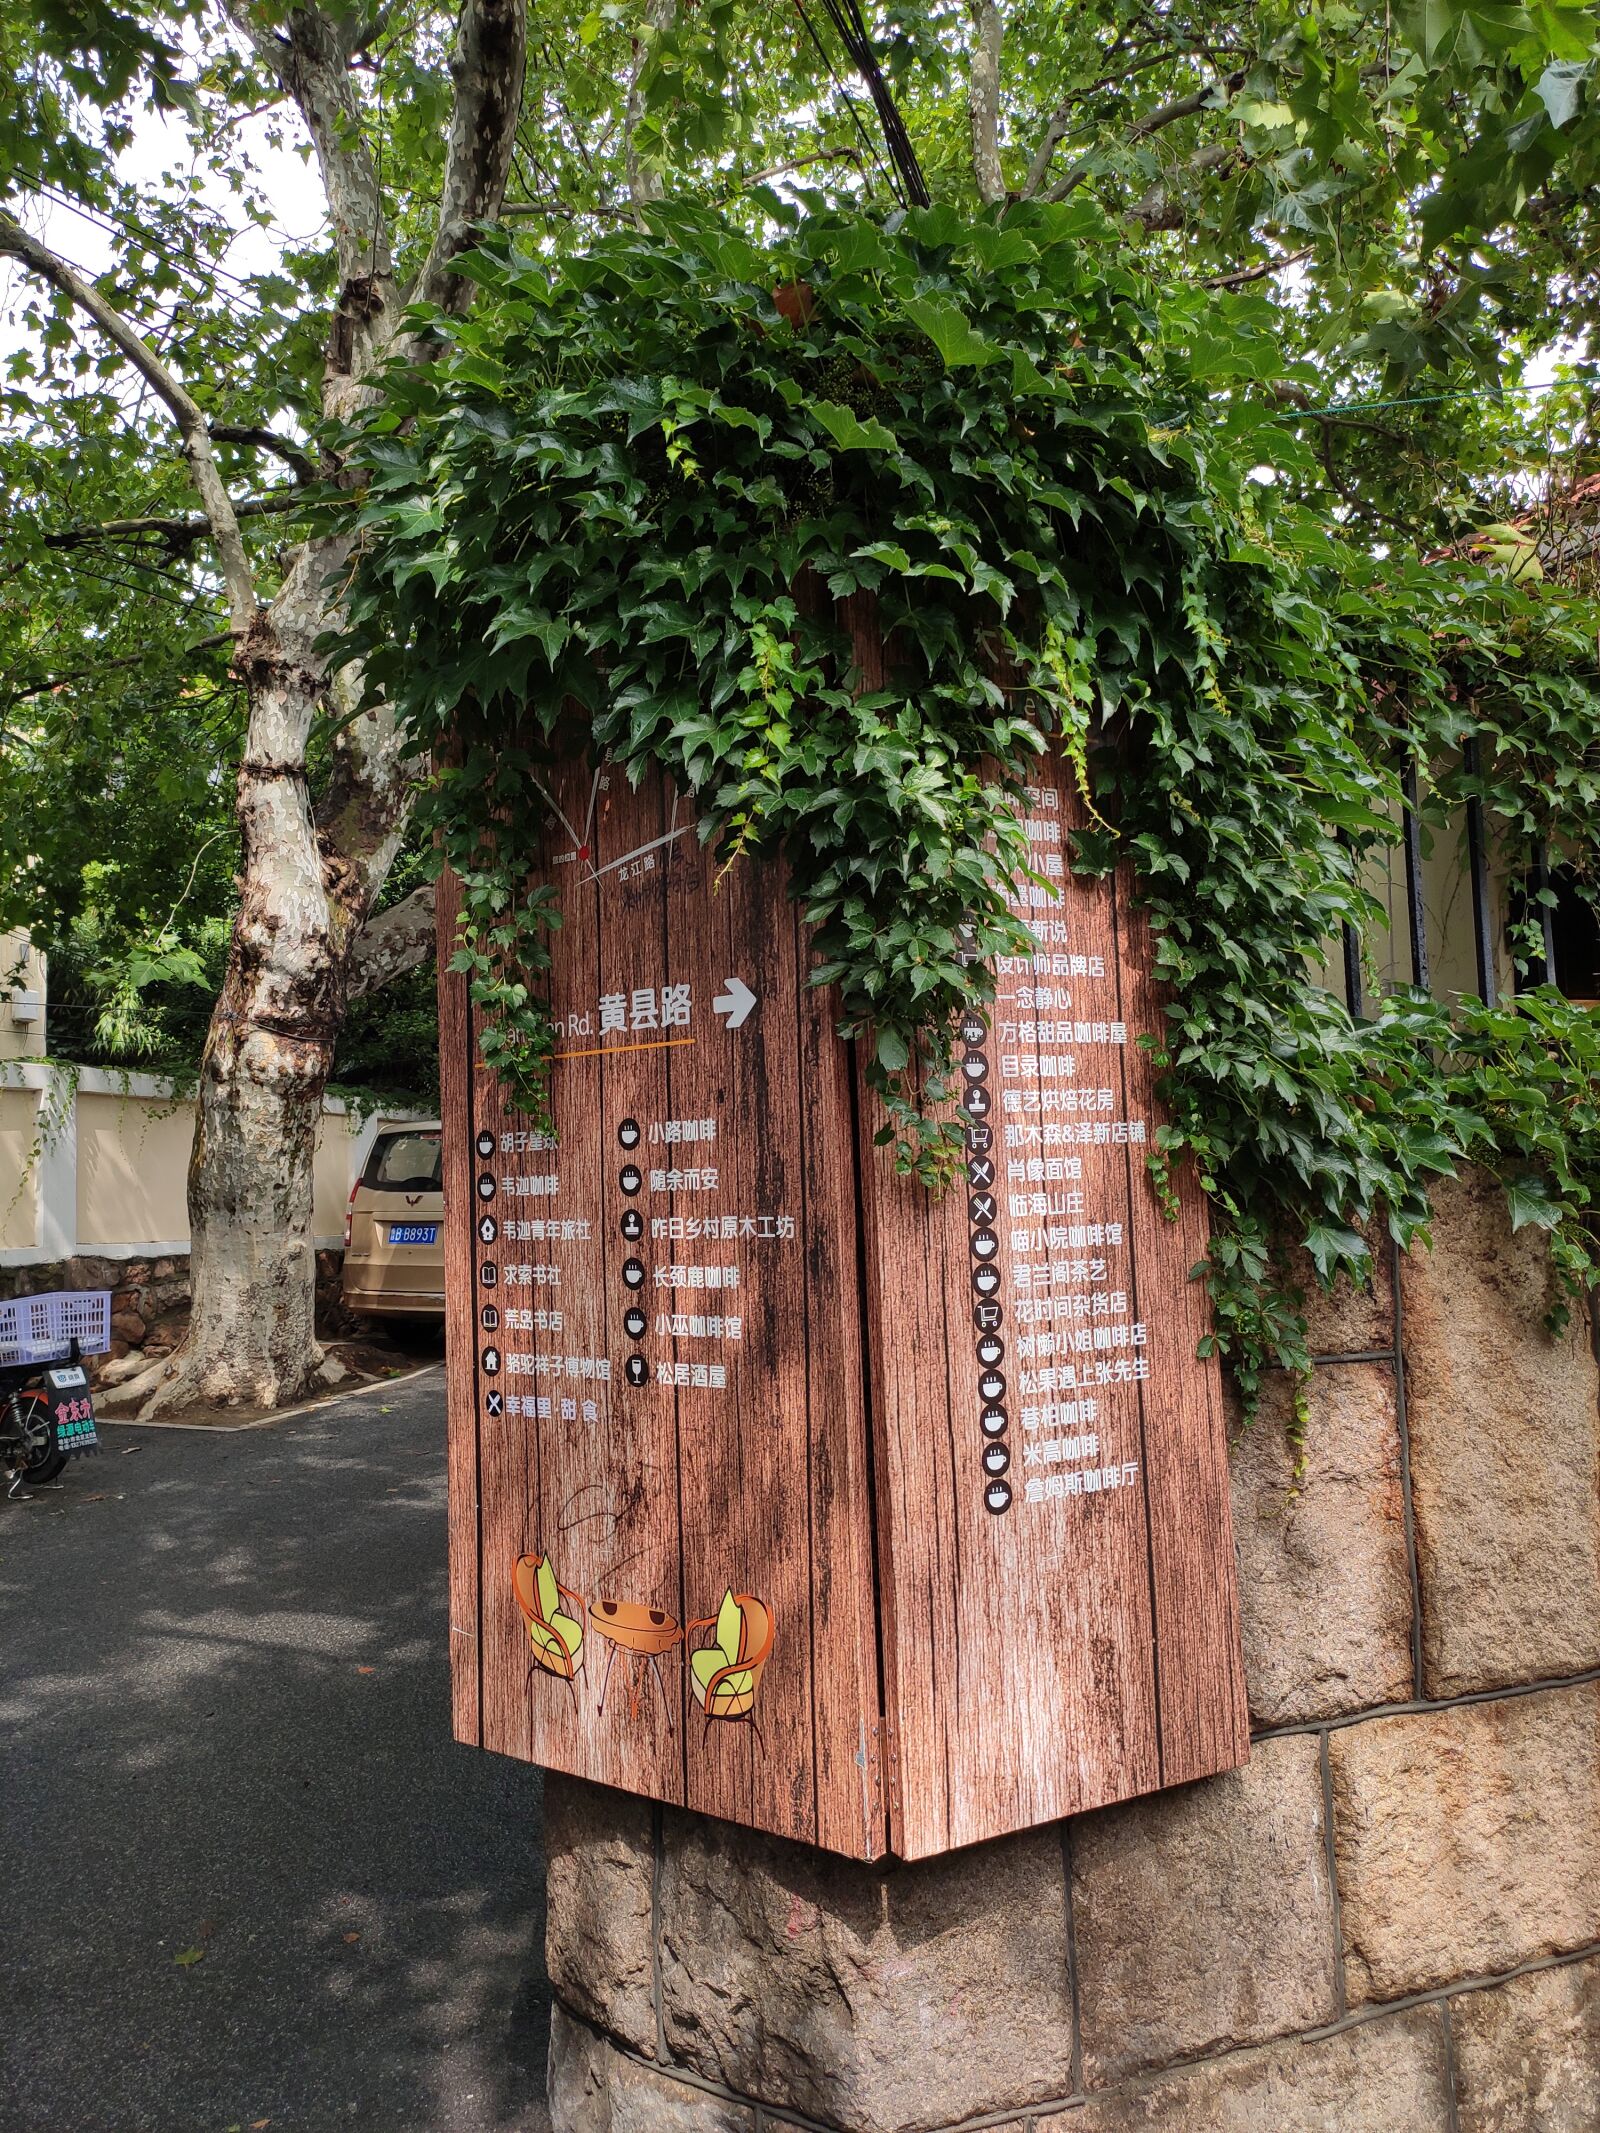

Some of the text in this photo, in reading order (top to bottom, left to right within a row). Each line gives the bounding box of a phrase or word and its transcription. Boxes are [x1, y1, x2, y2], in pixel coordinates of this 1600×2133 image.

[618, 854, 656, 882] 龙江路
[995, 952, 1105, 977] 设计师品牌店
[598, 983, 692, 1036] 黄县路
[997, 985, 1071, 1010] 一念静心
[568, 1011, 594, 1037] Rd.
[999, 1020, 1128, 1044] 方格甜品咖啡屋
[1001, 1054, 1076, 1078] 目录咖啡
[1002, 1088, 1114, 1113] 德艺烘焙花房
[648, 1117, 717, 1145] 小路咖啡
[1004, 1120, 1147, 1148] 那木森&泽新店铺
[649, 1167, 719, 1193] 随余而安
[1007, 1156, 1082, 1183] 肖像面馆
[1008, 1191, 1085, 1218] 临海山庄
[651, 1214, 796, 1241] 昨日乡村原木工坊
[1010, 1222, 1123, 1253] 喵小院咖啡馆
[503, 1264, 562, 1286] 求索书社
[652, 1265, 741, 1290] 长颈鹿咖啡
[1013, 1257, 1108, 1288] 君兰阁茶艺
[504, 1308, 563, 1331] 荒岛书店
[1014, 1291, 1128, 1325] 花时间杂货店
[654, 1313, 742, 1340] 小巫咖啡馆
[1016, 1322, 1148, 1360] 树懒小姐咖啡店
[505, 1352, 611, 1381] 骆驼祥子博物馆
[656, 1361, 727, 1389] 松居酒屋
[1018, 1356, 1151, 1396] 松果遇上张先生
[1022, 1432, 1101, 1468] 米高咖啡
[1024, 1461, 1139, 1504] 詹姆斯咖啡厅
